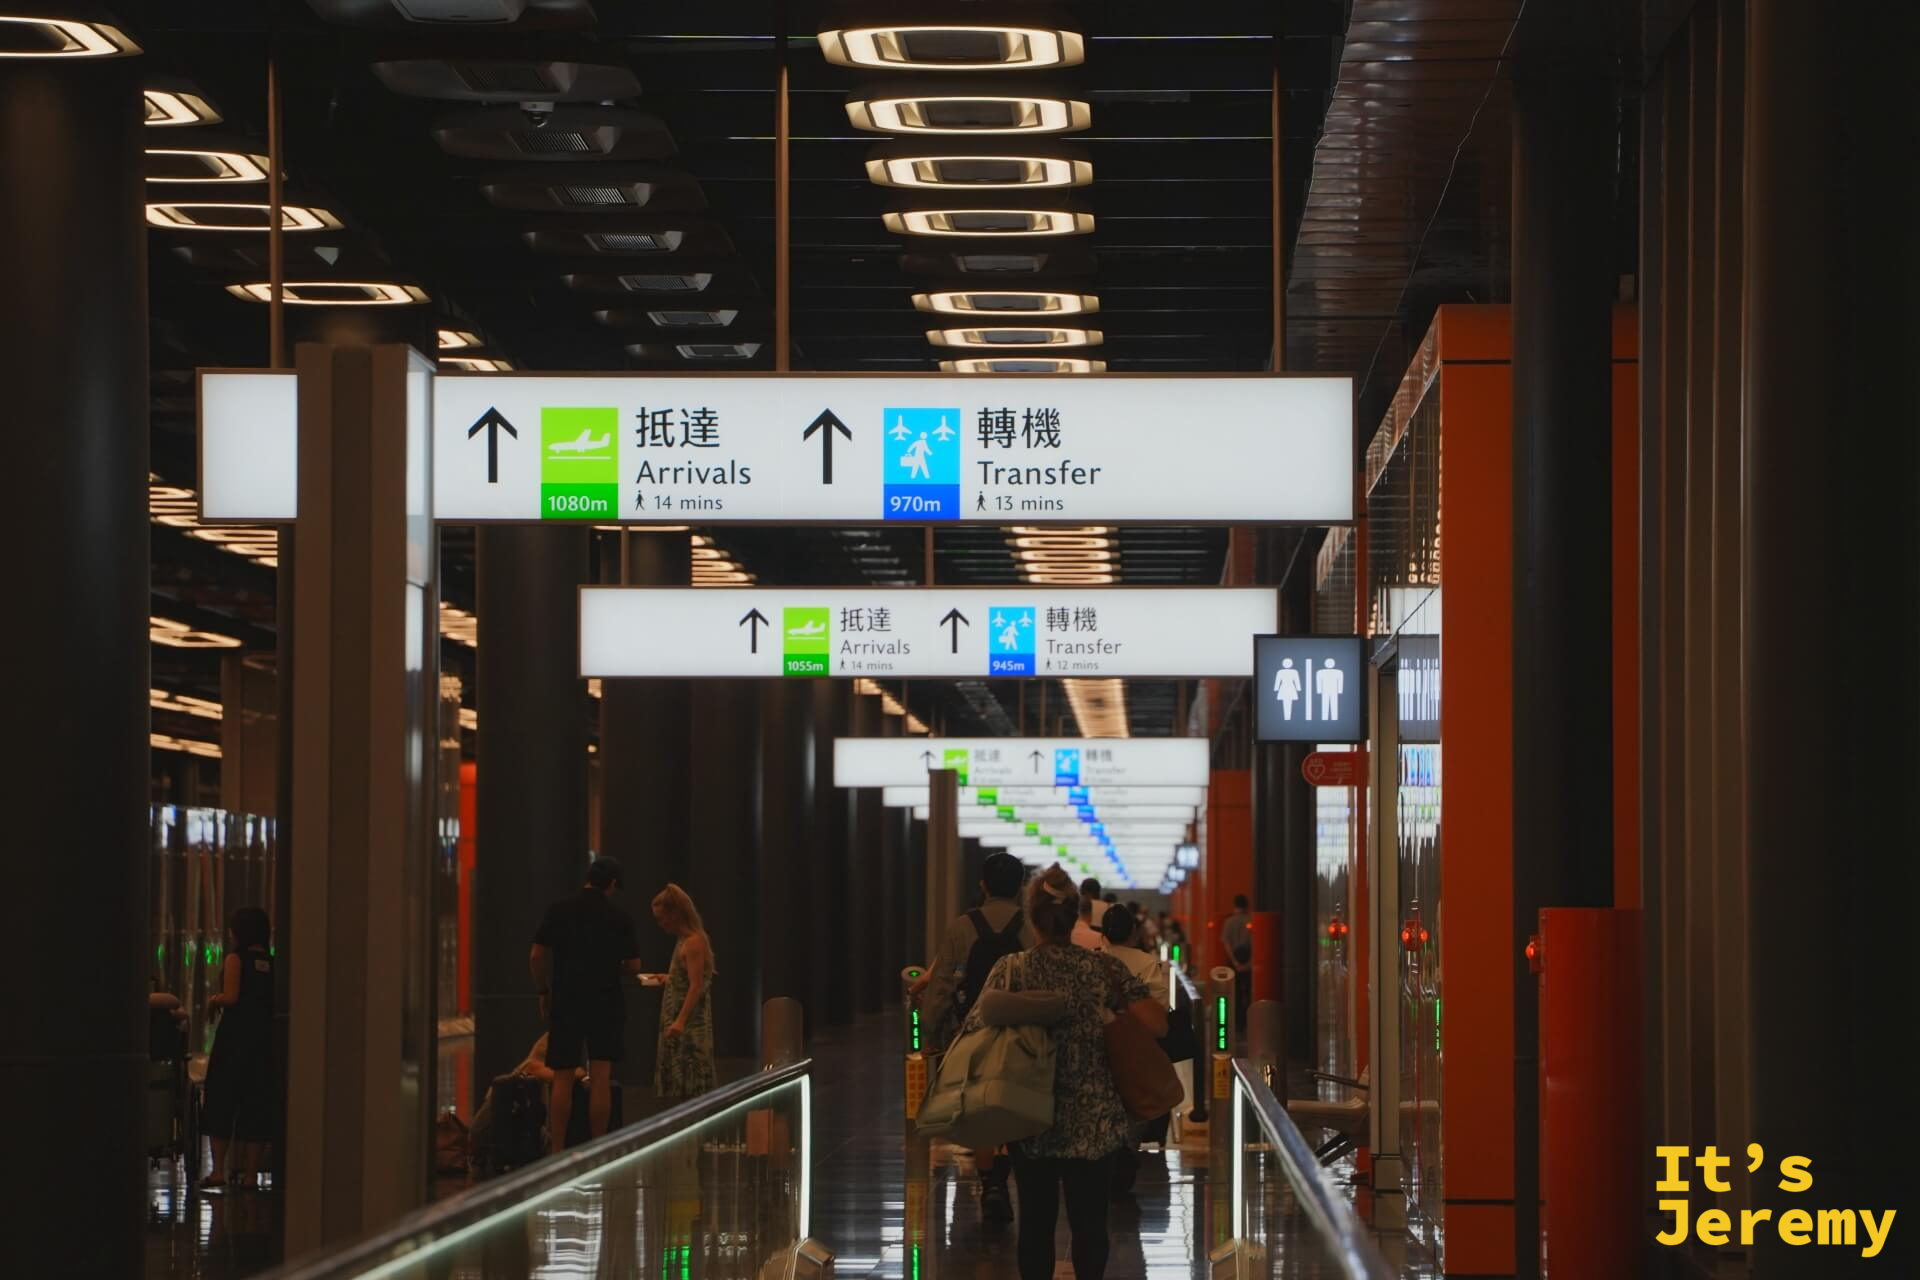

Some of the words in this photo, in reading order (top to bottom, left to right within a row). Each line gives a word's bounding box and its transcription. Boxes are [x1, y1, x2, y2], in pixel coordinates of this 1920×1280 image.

[635, 406, 720, 448] 抵達
[977, 407, 1061, 449] 轉機
[635, 459, 752, 485] Arrivals
[977, 459, 1102, 485] Transfer
[548, 495, 609, 512] 1080m
[654, 495, 673, 510] 14
[680, 495, 723, 510] mins
[890, 495, 941, 512] 970m
[995, 495, 1014, 511] 13
[1021, 495, 1064, 511] mins
[840, 607, 891, 632] 抵達
[1047, 607, 1098, 632] 轉機
[840, 639, 911, 655] Arrivals
[1047, 639, 1122, 655] Transfer
[787, 660, 824, 671] 1055m
[866, 661, 894, 671] mins
[992, 660, 1025, 671] 945m
[1072, 661, 1099, 670] mins
